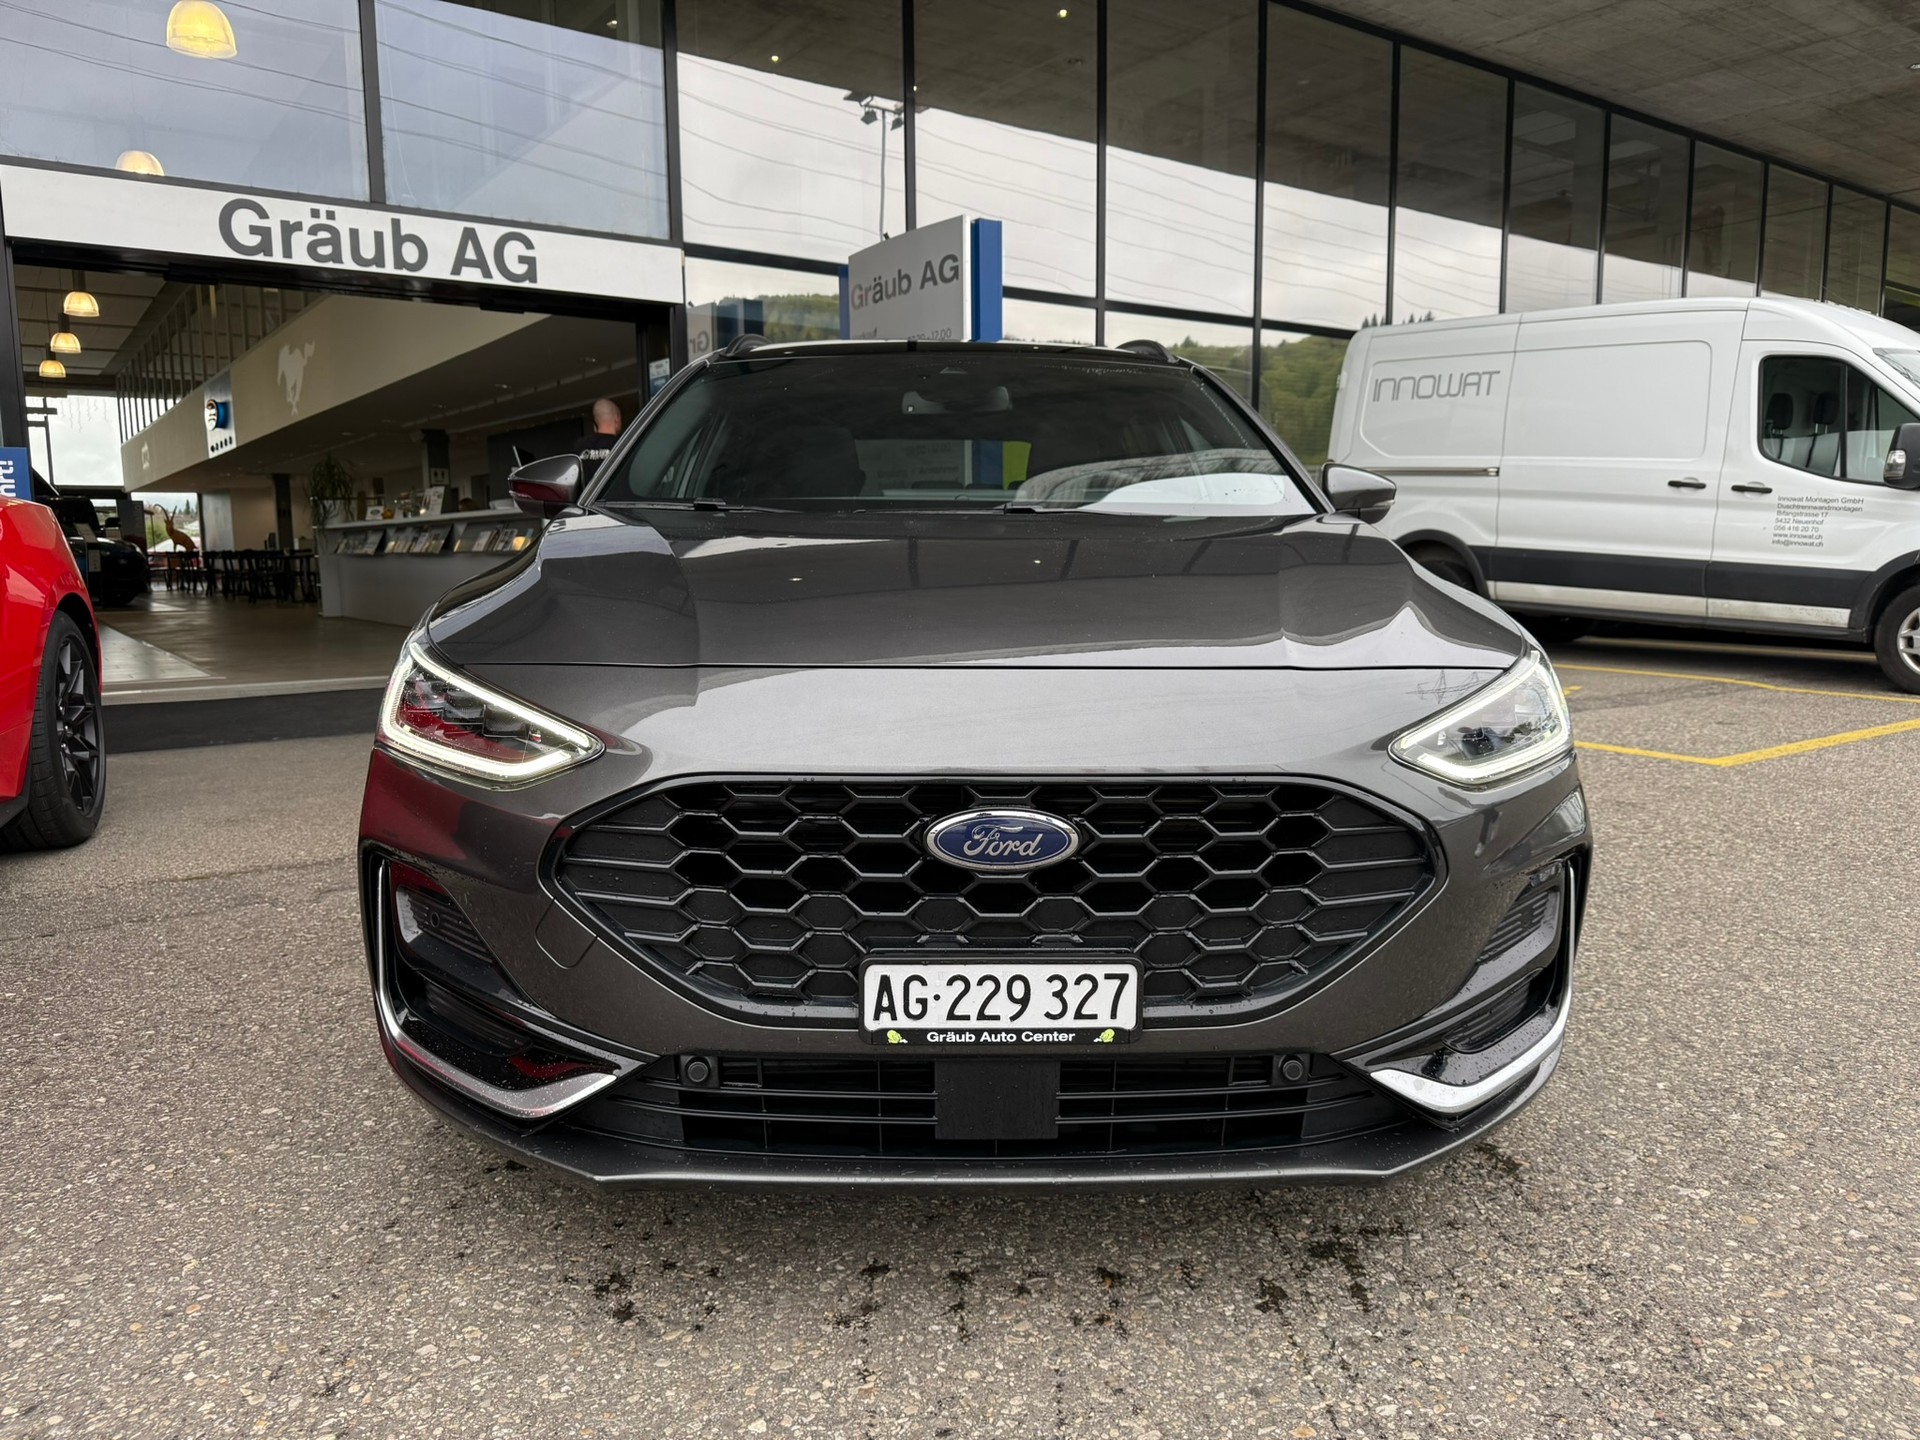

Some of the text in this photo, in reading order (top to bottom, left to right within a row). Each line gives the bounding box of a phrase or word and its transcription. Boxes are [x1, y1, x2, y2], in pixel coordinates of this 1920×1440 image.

[218, 198, 538, 284] Gräub AG
[851, 253, 960, 311] Gräub AG
[1372, 370, 1501, 402] INNOWAT
[1805, 496, 1839, 504] Montagen
[963, 824, 1044, 856] Ford
[1043, 973, 1130, 1020] 327
[926, 1031, 1076, 1042] Gräub Auto Center
